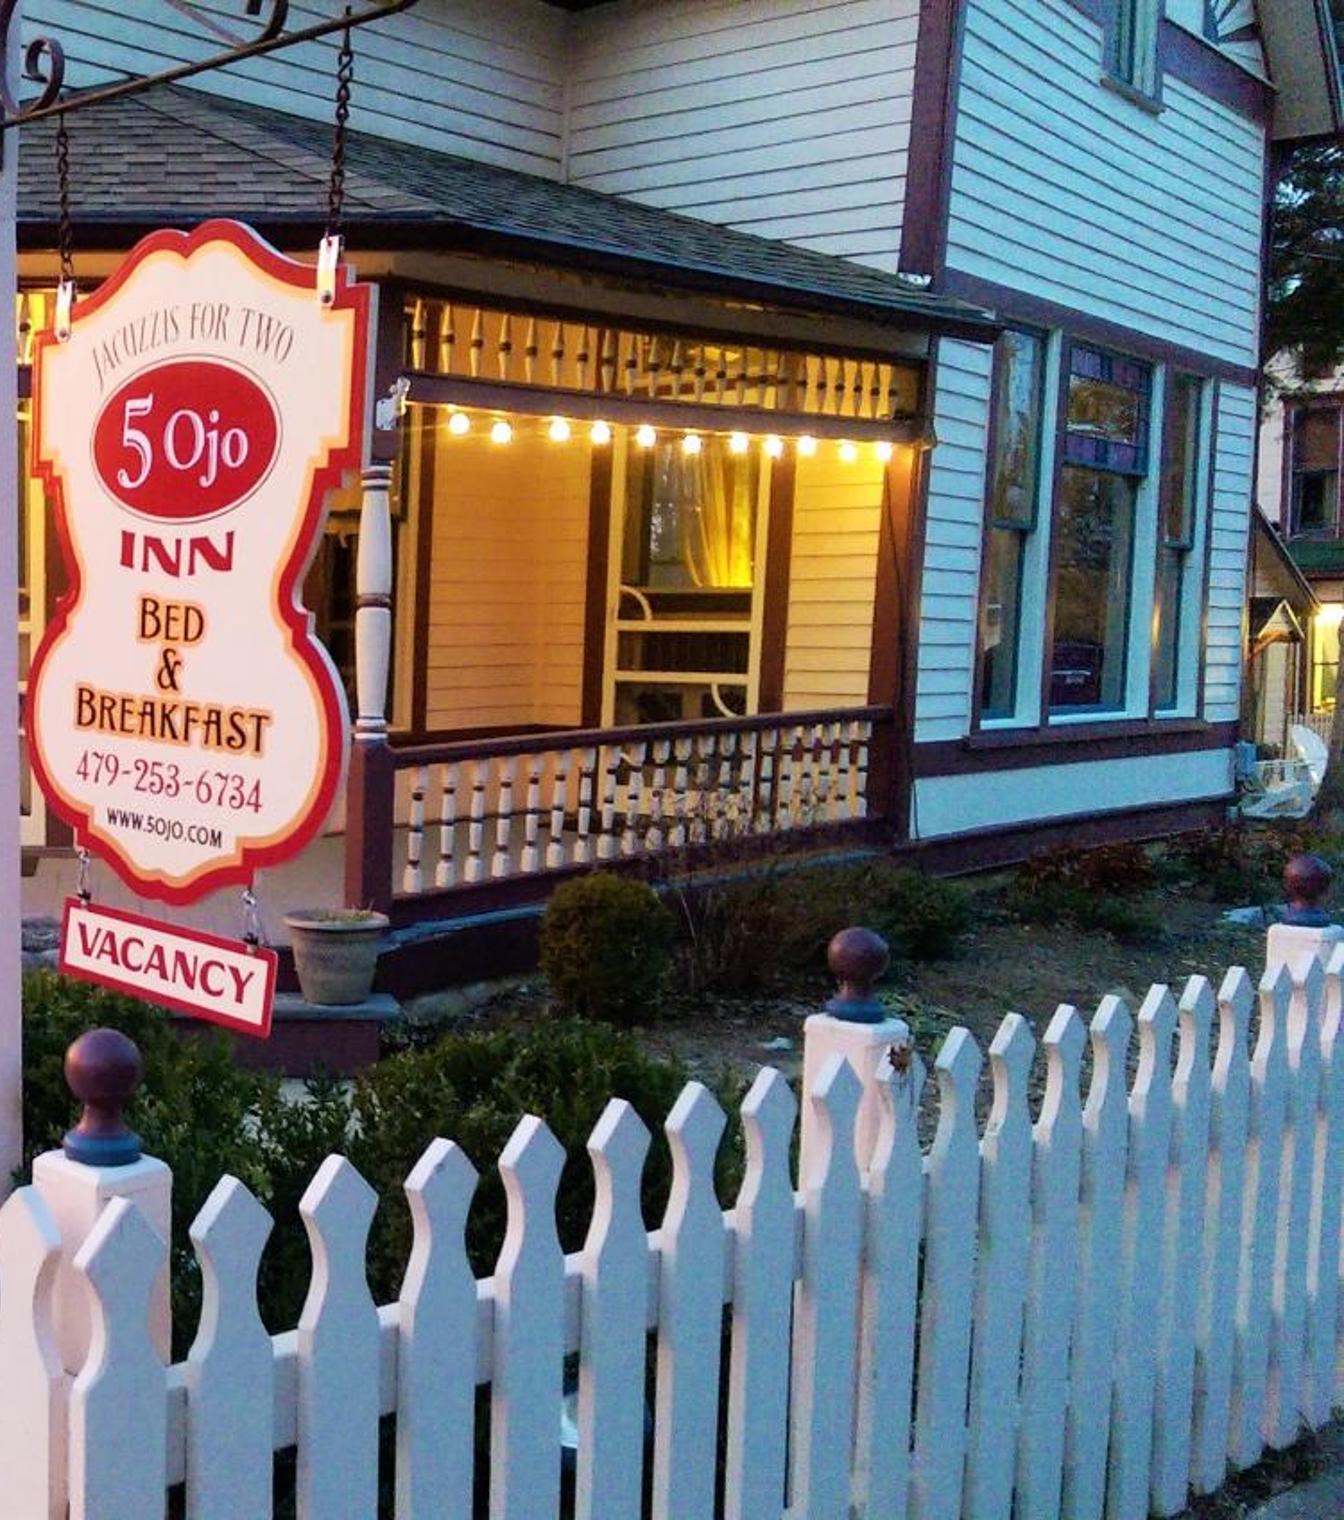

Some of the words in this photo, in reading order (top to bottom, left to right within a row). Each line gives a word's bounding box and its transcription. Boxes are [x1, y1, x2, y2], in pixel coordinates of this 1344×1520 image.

[92, 306, 180, 393] JACUZZIS
[190, 303, 230, 342] FOR
[240, 307, 295, 364] TWO
[119, 529, 236, 579] INN
[139, 597, 204, 642] BED
[156, 648, 183, 692] &
[75, 687, 271, 754] BREAKFAST
[75, 748, 264, 814] 479-253-6734
[77, 921, 256, 1005] VACANCY
